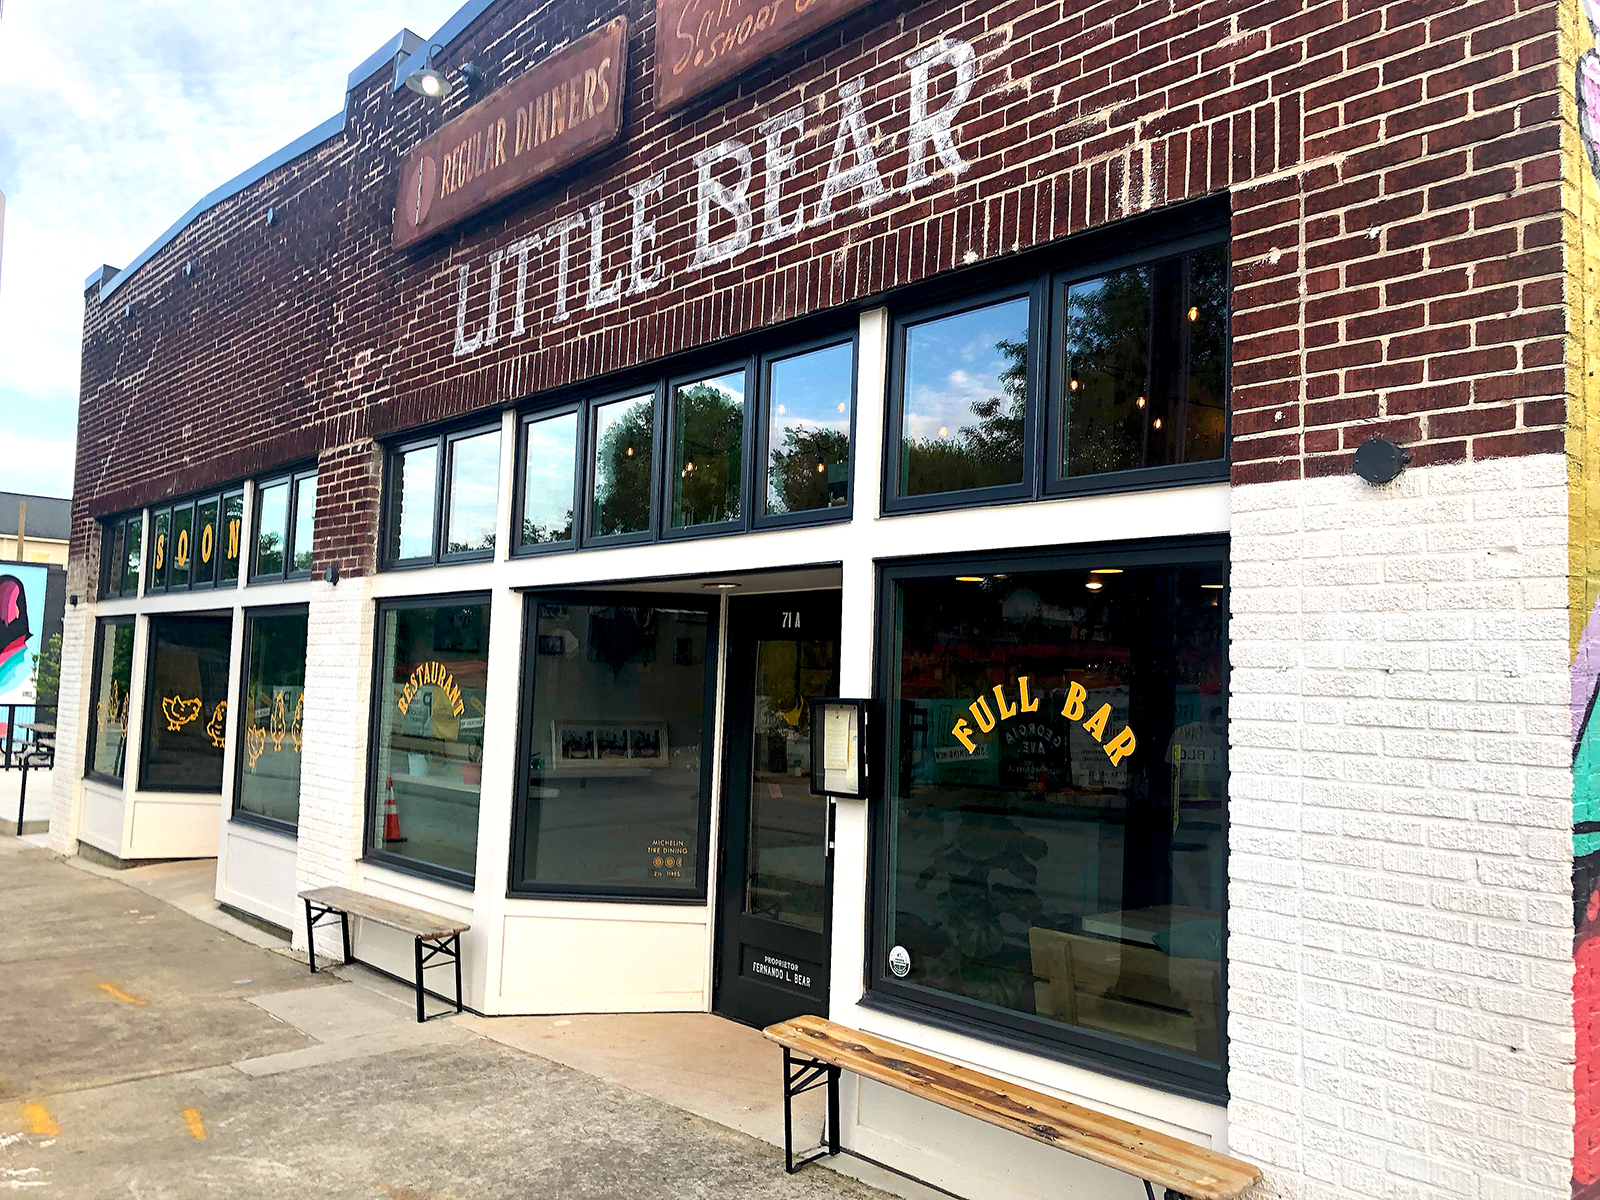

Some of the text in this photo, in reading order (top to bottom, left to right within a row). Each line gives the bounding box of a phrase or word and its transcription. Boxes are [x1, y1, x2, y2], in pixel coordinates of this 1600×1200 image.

[704, 0, 784, 68] SHORT
[441, 57, 611, 200] REGULAR DINNERS
[453, 37, 976, 357] LITTLE BEAR
[156, 519, 239, 569] SOON
[782, 611, 801, 628] 71 A
[397, 661, 465, 717] RESTAURANT
[952, 676, 1136, 767] FULL BAR
[651, 839, 684, 847] MICHELIN
[662, 847, 688, 855] DINING
[752, 961, 811, 988] FERNANDO L. BEAR
[764, 955, 799, 972] PROPRIETOR
